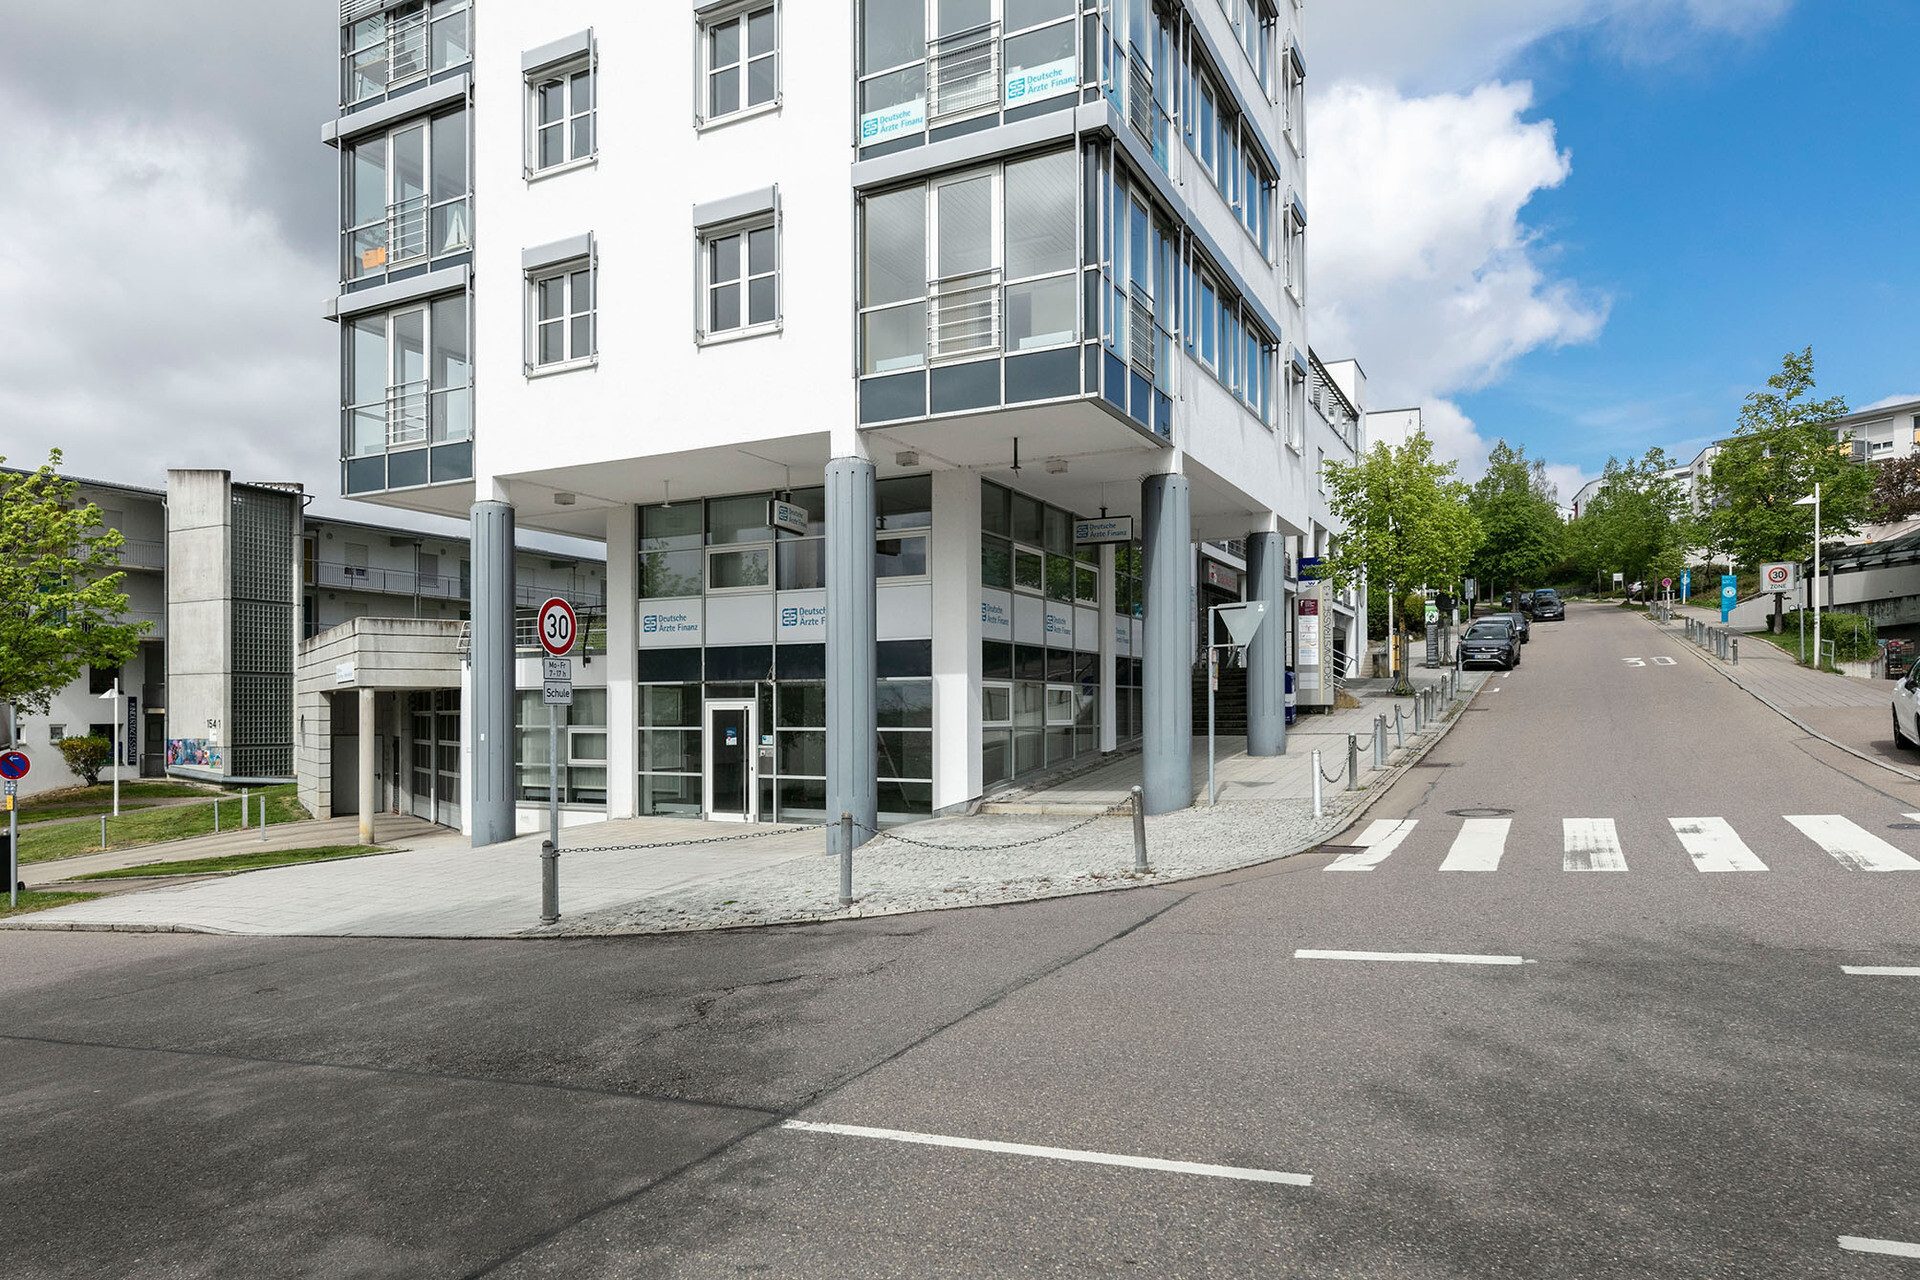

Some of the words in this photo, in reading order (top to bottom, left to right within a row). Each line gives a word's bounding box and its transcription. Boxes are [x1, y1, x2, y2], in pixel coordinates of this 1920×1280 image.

[1027, 68, 1063, 84] Deutsche
[1028, 82, 1048, 95] Ärzte
[1051, 75, 1076, 89] Finanz
[880, 109, 911, 124] Deutsche
[880, 121, 899, 133] Ärzte
[901, 115, 924, 128] Finanz
[1090, 522, 1117, 530] Deutsche
[1772, 571, 1784, 579] 30
[658, 614, 687, 622] Deutsche
[800, 615, 819, 625] Ärzte
[547, 613, 569, 640] 30
[678, 623, 698, 631] Finanz
[1323, 606, 1332, 690] VIRCHOWSTRASSE
[546, 688, 570, 698] Schule
